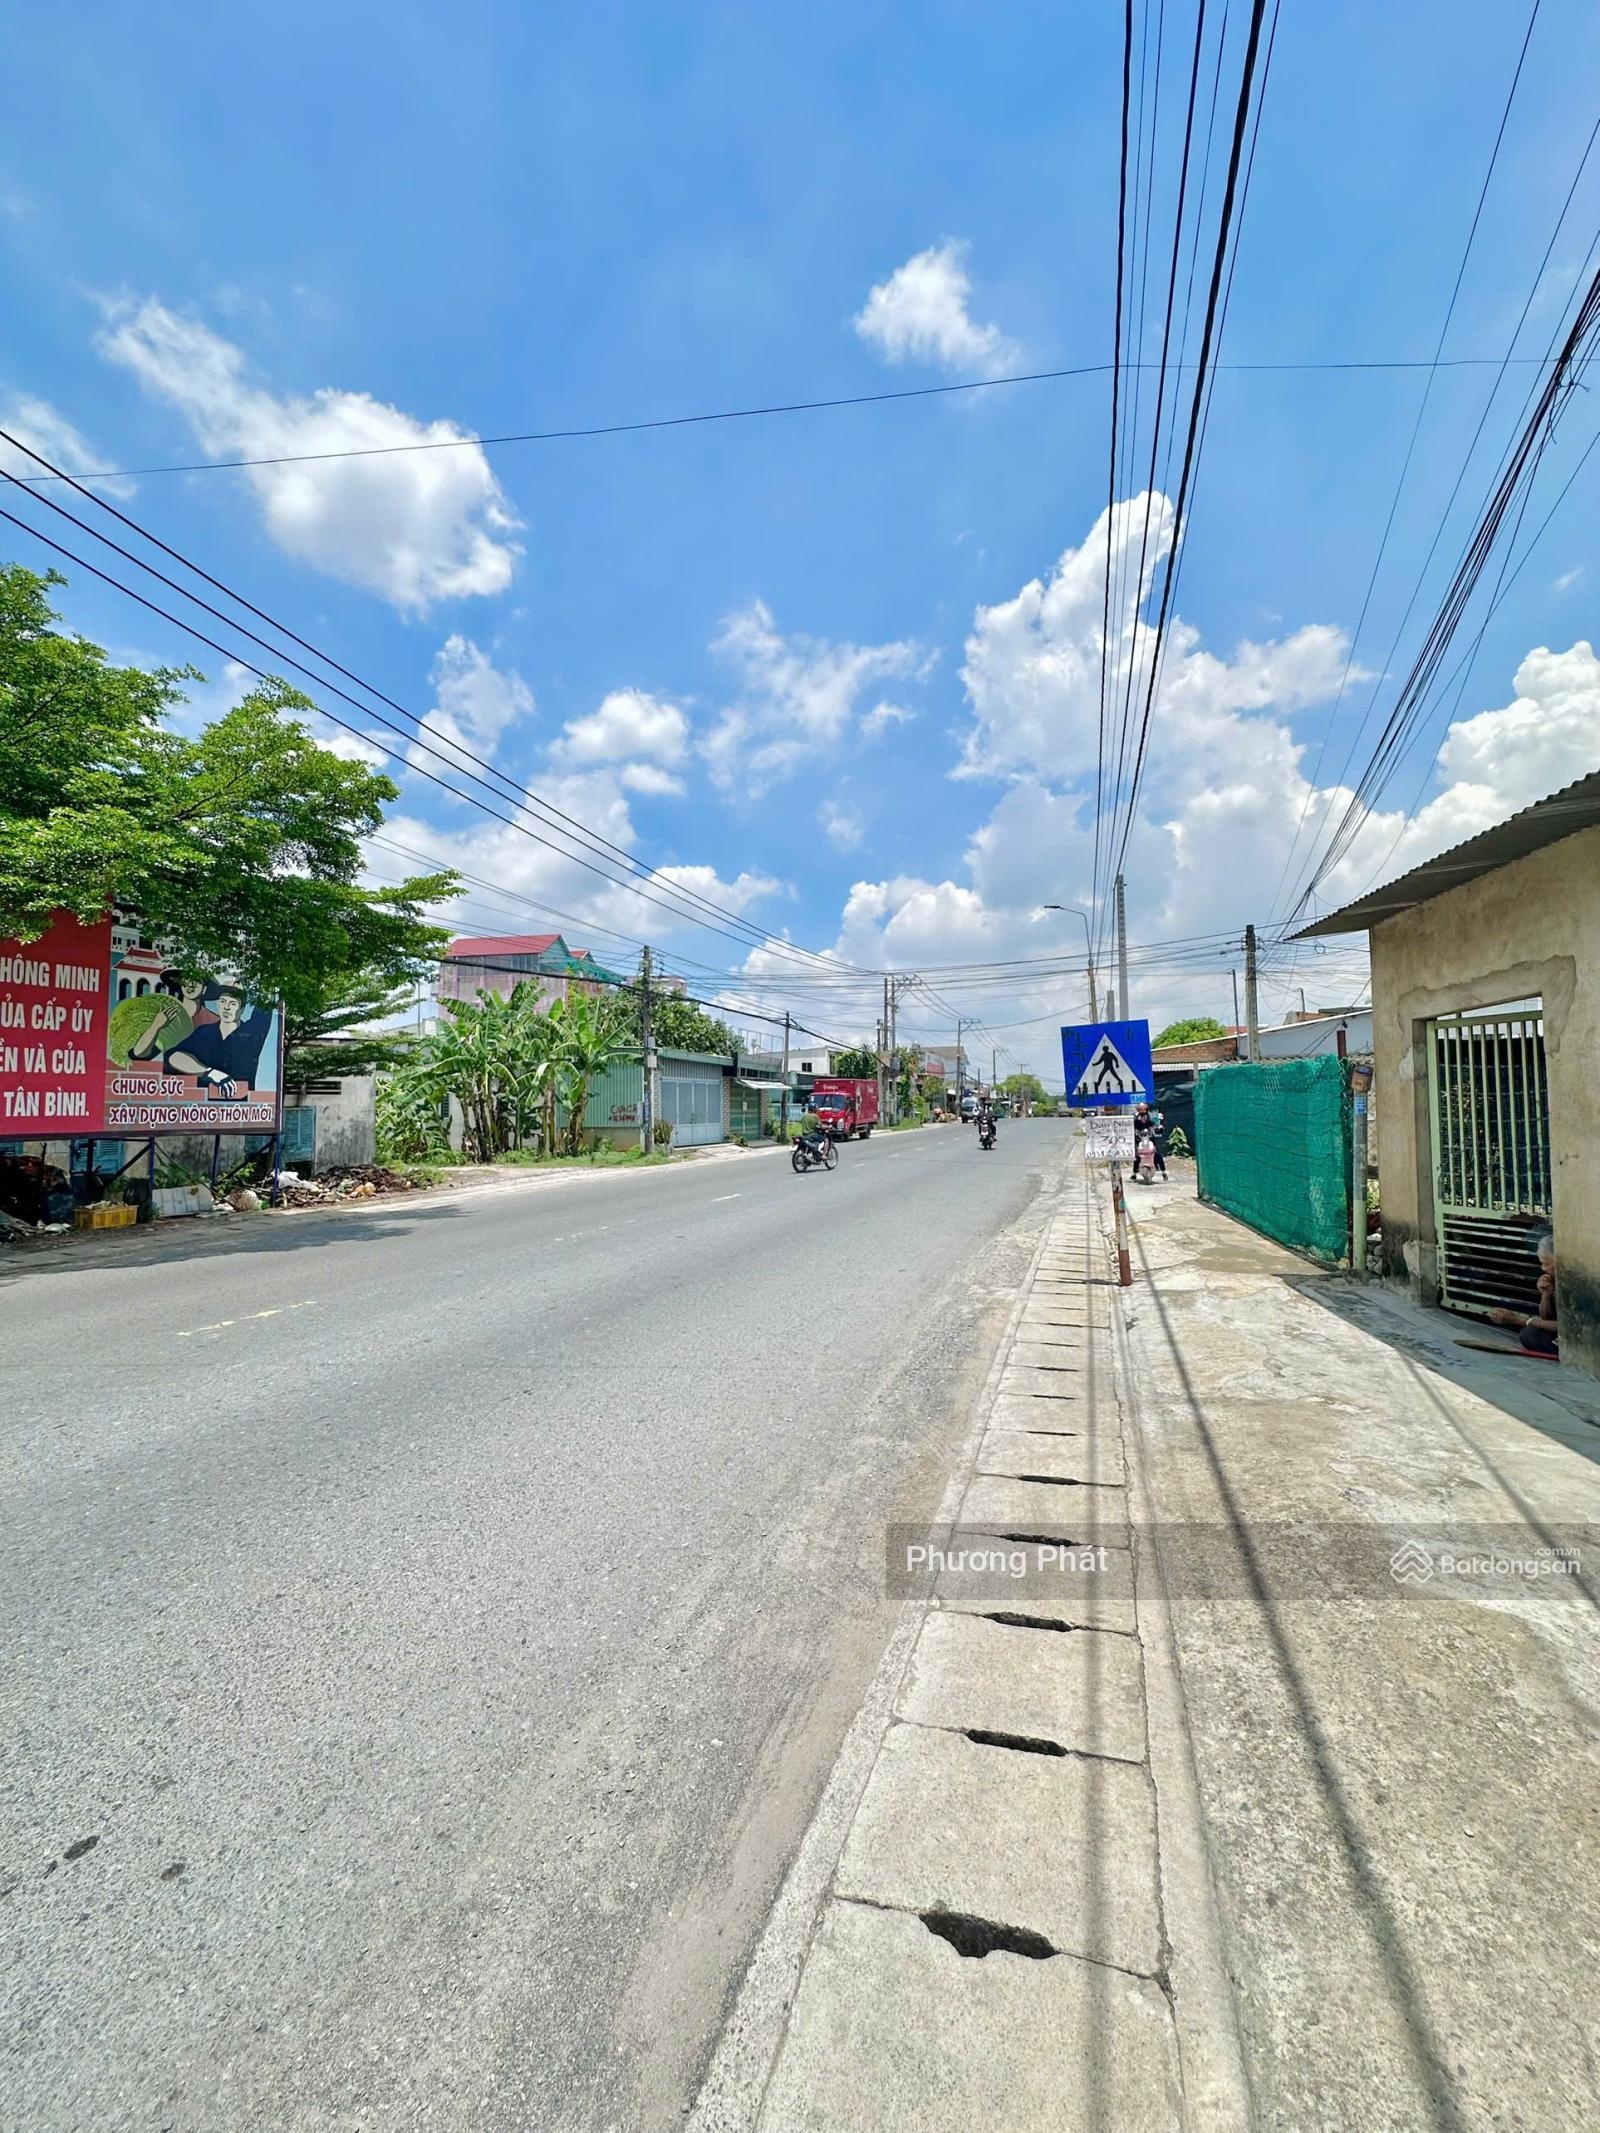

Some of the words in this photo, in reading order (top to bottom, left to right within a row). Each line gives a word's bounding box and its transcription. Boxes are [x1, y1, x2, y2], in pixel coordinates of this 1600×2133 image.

[55, 963, 100, 992] MINH
[31, 996, 67, 1031] CẤP
[71, 999, 94, 1033] ỦY
[23, 1042, 47, 1073] VÀ
[52, 1041, 86, 1074] CỦA
[112, 1078, 157, 1096] CHUNG
[160, 1075, 184, 1095] SỨC
[3, 1085, 40, 1117] TÂN
[44, 1086, 90, 1117] BÌNH.
[109, 1102, 136, 1124] XÂY
[138, 1105, 178, 1129] DỰNG
[180, 1102, 217, 1123] NÔNG
[220, 1103, 249, 1123] THÔN
[250, 1103, 273, 1123] MỚI
